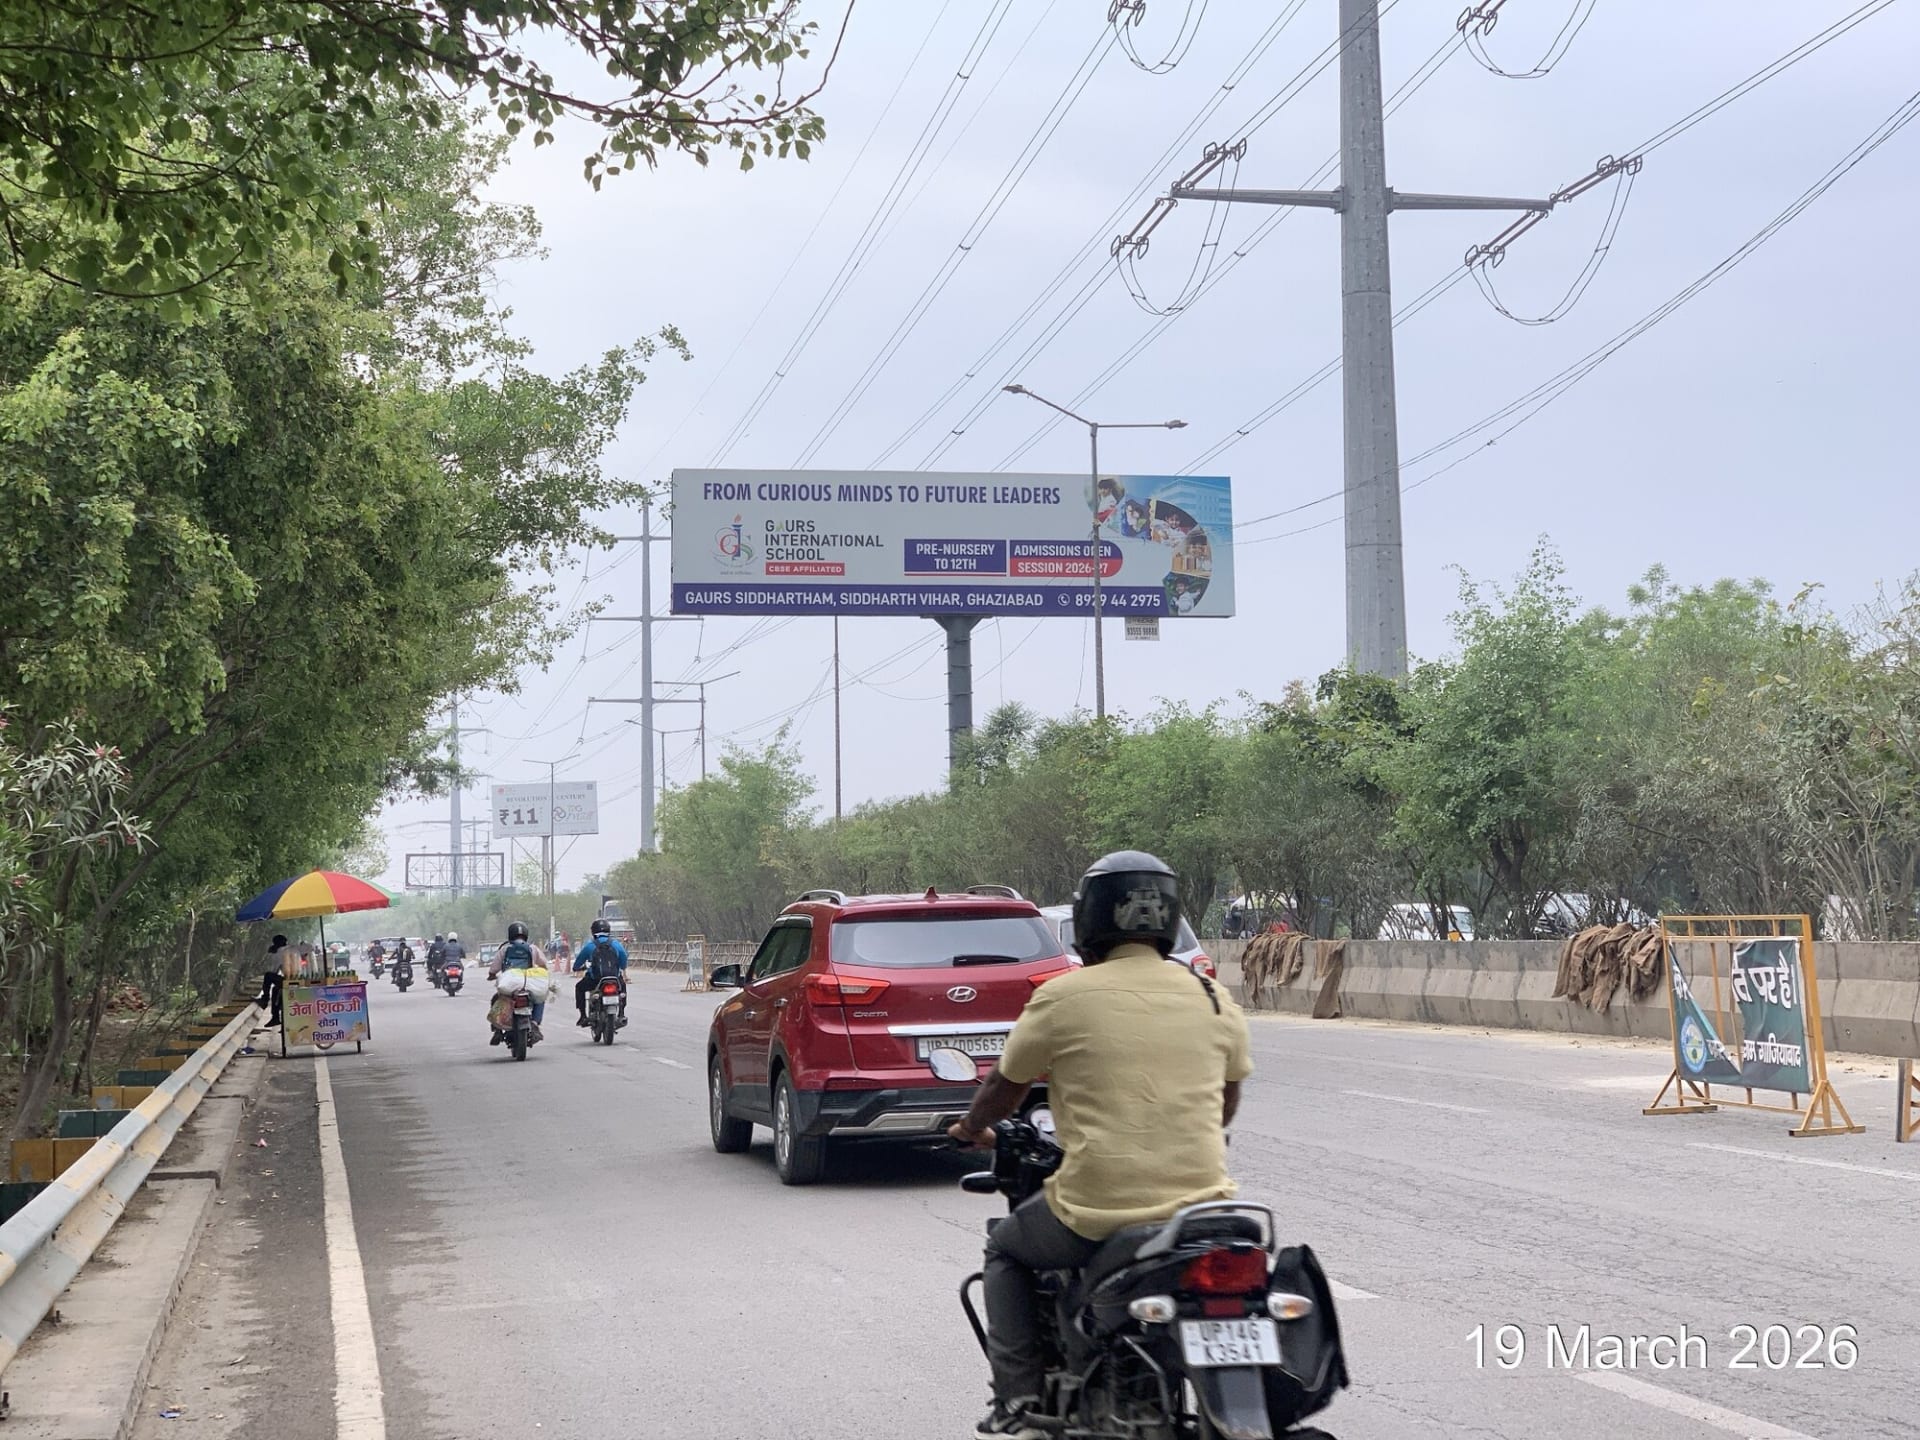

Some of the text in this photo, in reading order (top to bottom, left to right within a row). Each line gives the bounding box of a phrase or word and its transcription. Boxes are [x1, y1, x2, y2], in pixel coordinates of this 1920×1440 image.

[703, 483, 1060, 505] FROM CURIOUS MINDS TO FUTURE LEADERS
[765, 520, 815, 532] GAURS
[765, 533, 884, 547] INTERNATIONAL
[766, 548, 825, 560] SCHOOL
[916, 544, 995, 556] PRE-NURSERY
[1014, 545, 1111, 557] ADMISSIONS OEN
[768, 565, 842, 573] CBSE AFFILIATED
[934, 558, 977, 570] TO 12TH
[1018, 562, 1063, 573] SESSION
[685, 591, 732, 604] GAURS
[735, 592, 837, 607] SIDDHARTHAM,
[840, 593, 916, 606] SIDDHARTH
[919, 593, 964, 607] VIHAR,
[967, 593, 1043, 607] GHAZIABAD
[1111, 594, 1127, 606] 44
[1130, 594, 1161, 607] 2975
[1747, 966, 1778, 1004] पर
